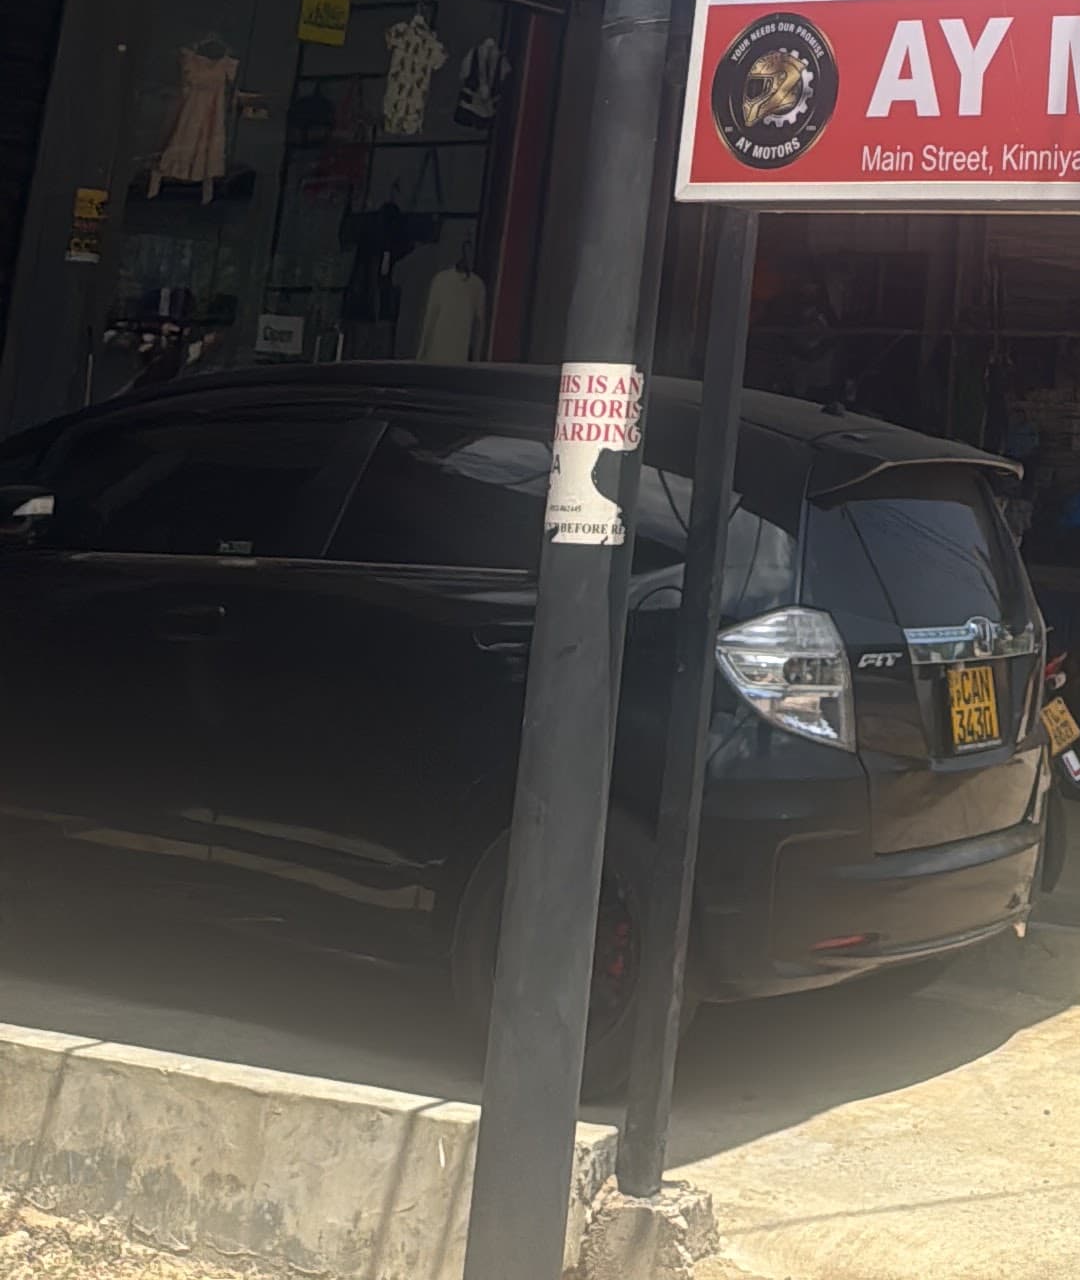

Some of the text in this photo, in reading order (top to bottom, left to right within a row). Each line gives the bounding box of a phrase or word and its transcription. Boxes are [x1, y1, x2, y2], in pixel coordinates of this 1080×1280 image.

[731, 22, 825, 62] YOUR NEEDS OUR PROMISE
[865, 17, 1013, 118] AY
[735, 136, 801, 160] AY MOTORS
[861, 144, 914, 172] Main
[920, 144, 993, 175] Street,
[586, 375, 608, 394] IS
[612, 377, 640, 395] AN
[558, 399, 640, 418] THORIS
[560, 524, 608, 534] BEFORE
[858, 652, 903, 668] FIT
